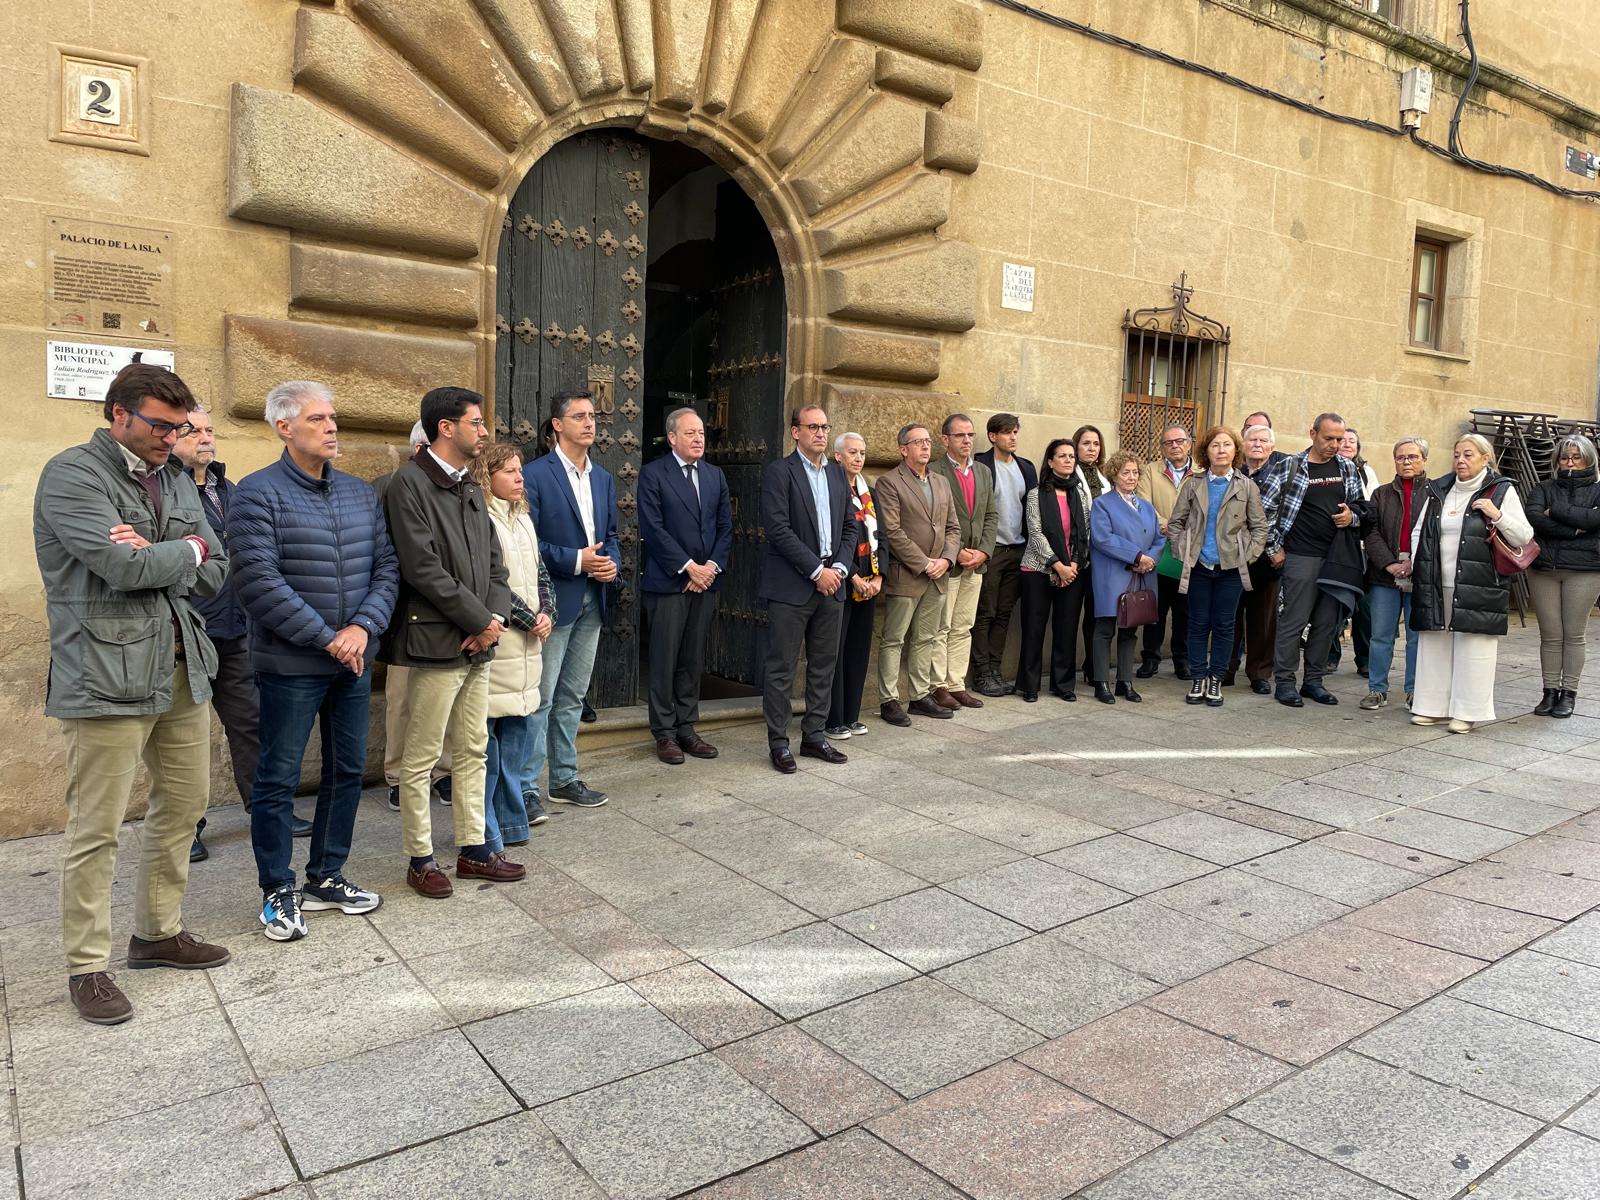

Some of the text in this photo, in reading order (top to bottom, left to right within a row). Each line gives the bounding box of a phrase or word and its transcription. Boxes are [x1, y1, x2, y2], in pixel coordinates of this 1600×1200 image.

[87, 80, 112, 115] 2
[60, 233, 161, 254] PALACIO DE LA ISLA
[54, 346, 114, 358] BIBLIOTECA
[54, 354, 109, 366] MUNICIPAL
[54, 365, 75, 373] Julián
